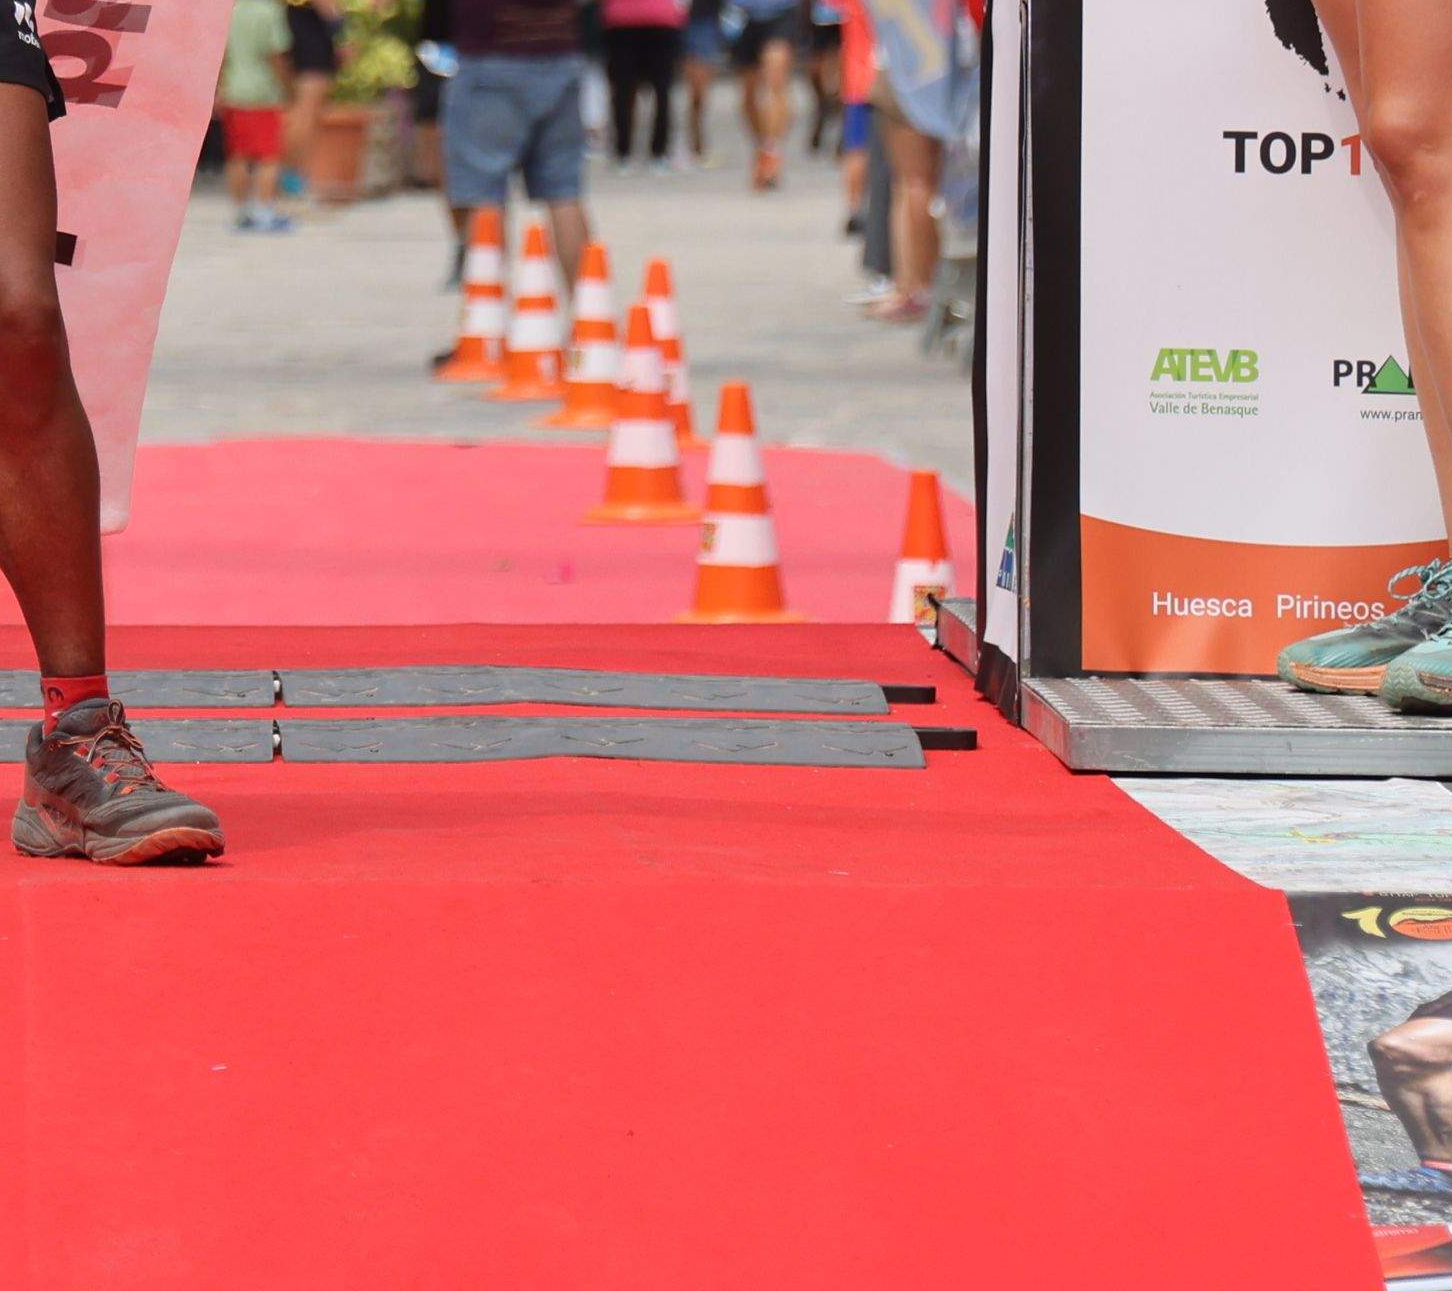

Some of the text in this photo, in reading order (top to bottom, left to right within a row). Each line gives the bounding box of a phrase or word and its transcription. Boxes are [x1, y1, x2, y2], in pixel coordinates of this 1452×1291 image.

[1150, 347, 1260, 383] ATEVB
[1149, 401, 1259, 419] Valle de Benasque
[1152, 591, 1253, 619] Huesca
[1277, 593, 1386, 622] Pirineos
